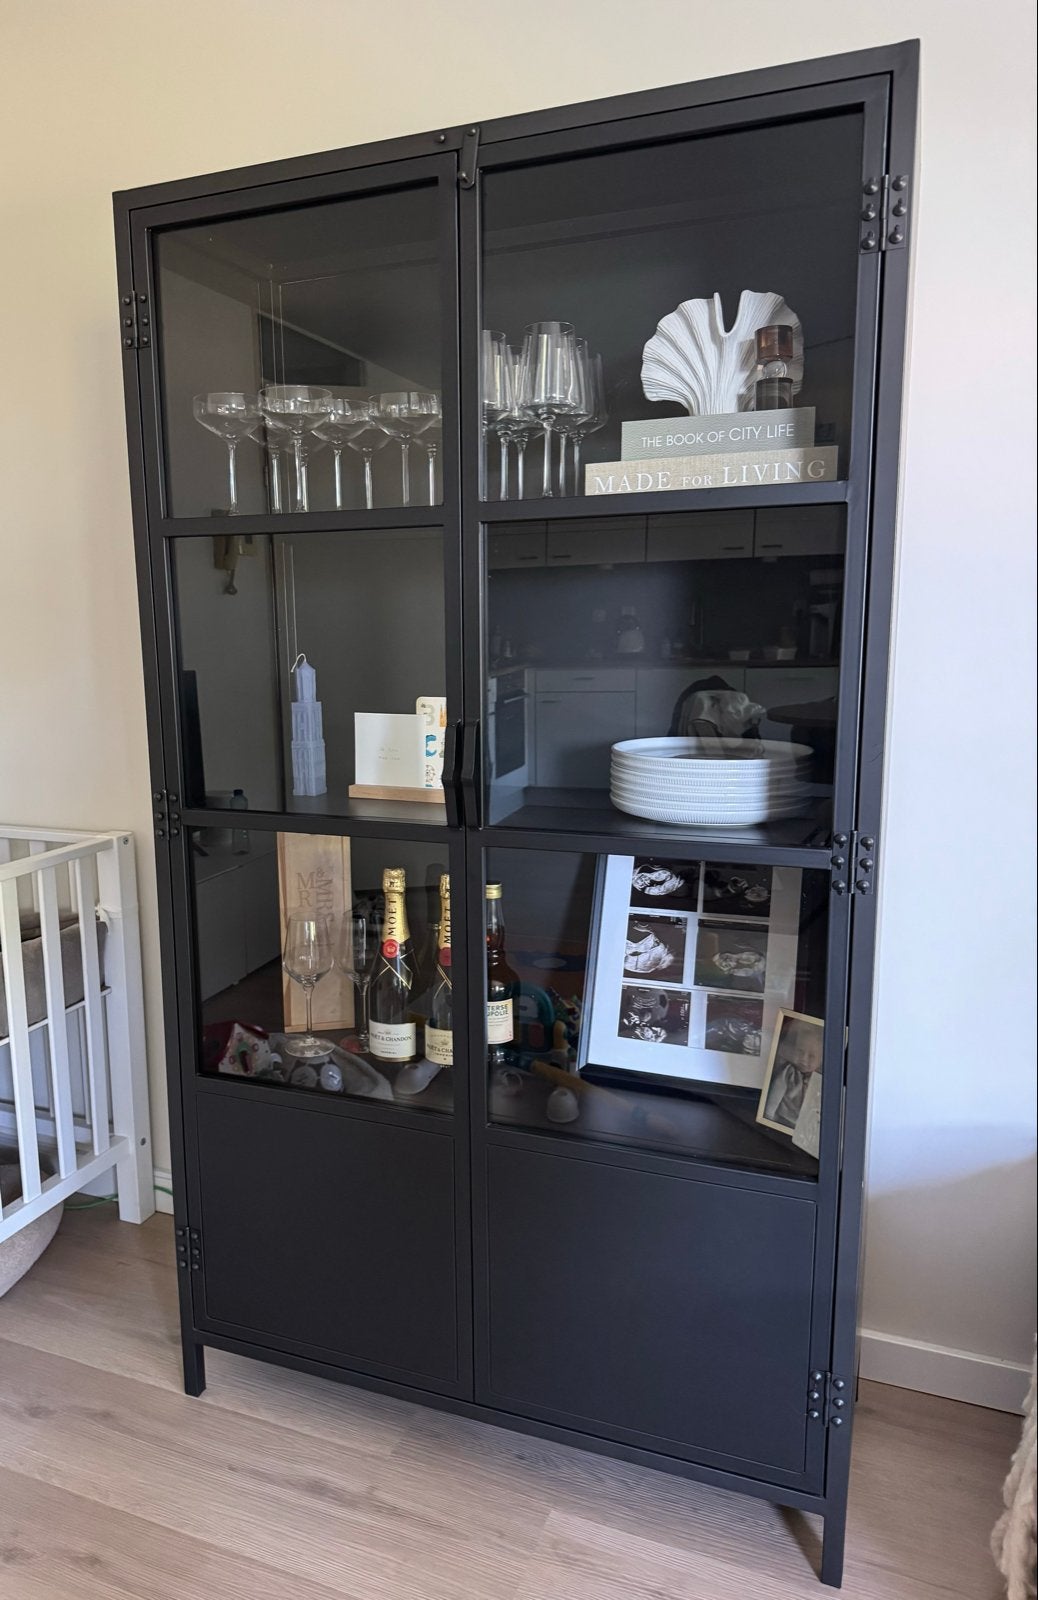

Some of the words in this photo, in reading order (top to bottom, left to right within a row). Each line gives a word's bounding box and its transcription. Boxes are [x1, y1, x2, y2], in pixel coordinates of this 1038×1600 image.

[641, 435, 663, 448] THE
[666, 432, 704, 446] BOOK
[707, 430, 726, 443] OF
[729, 425, 762, 441] CITY
[767, 423, 795, 438] LIFE
[594, 471, 672, 495] MADE
[682, 474, 713, 487] FOR
[722, 460, 825, 485] LIVING
